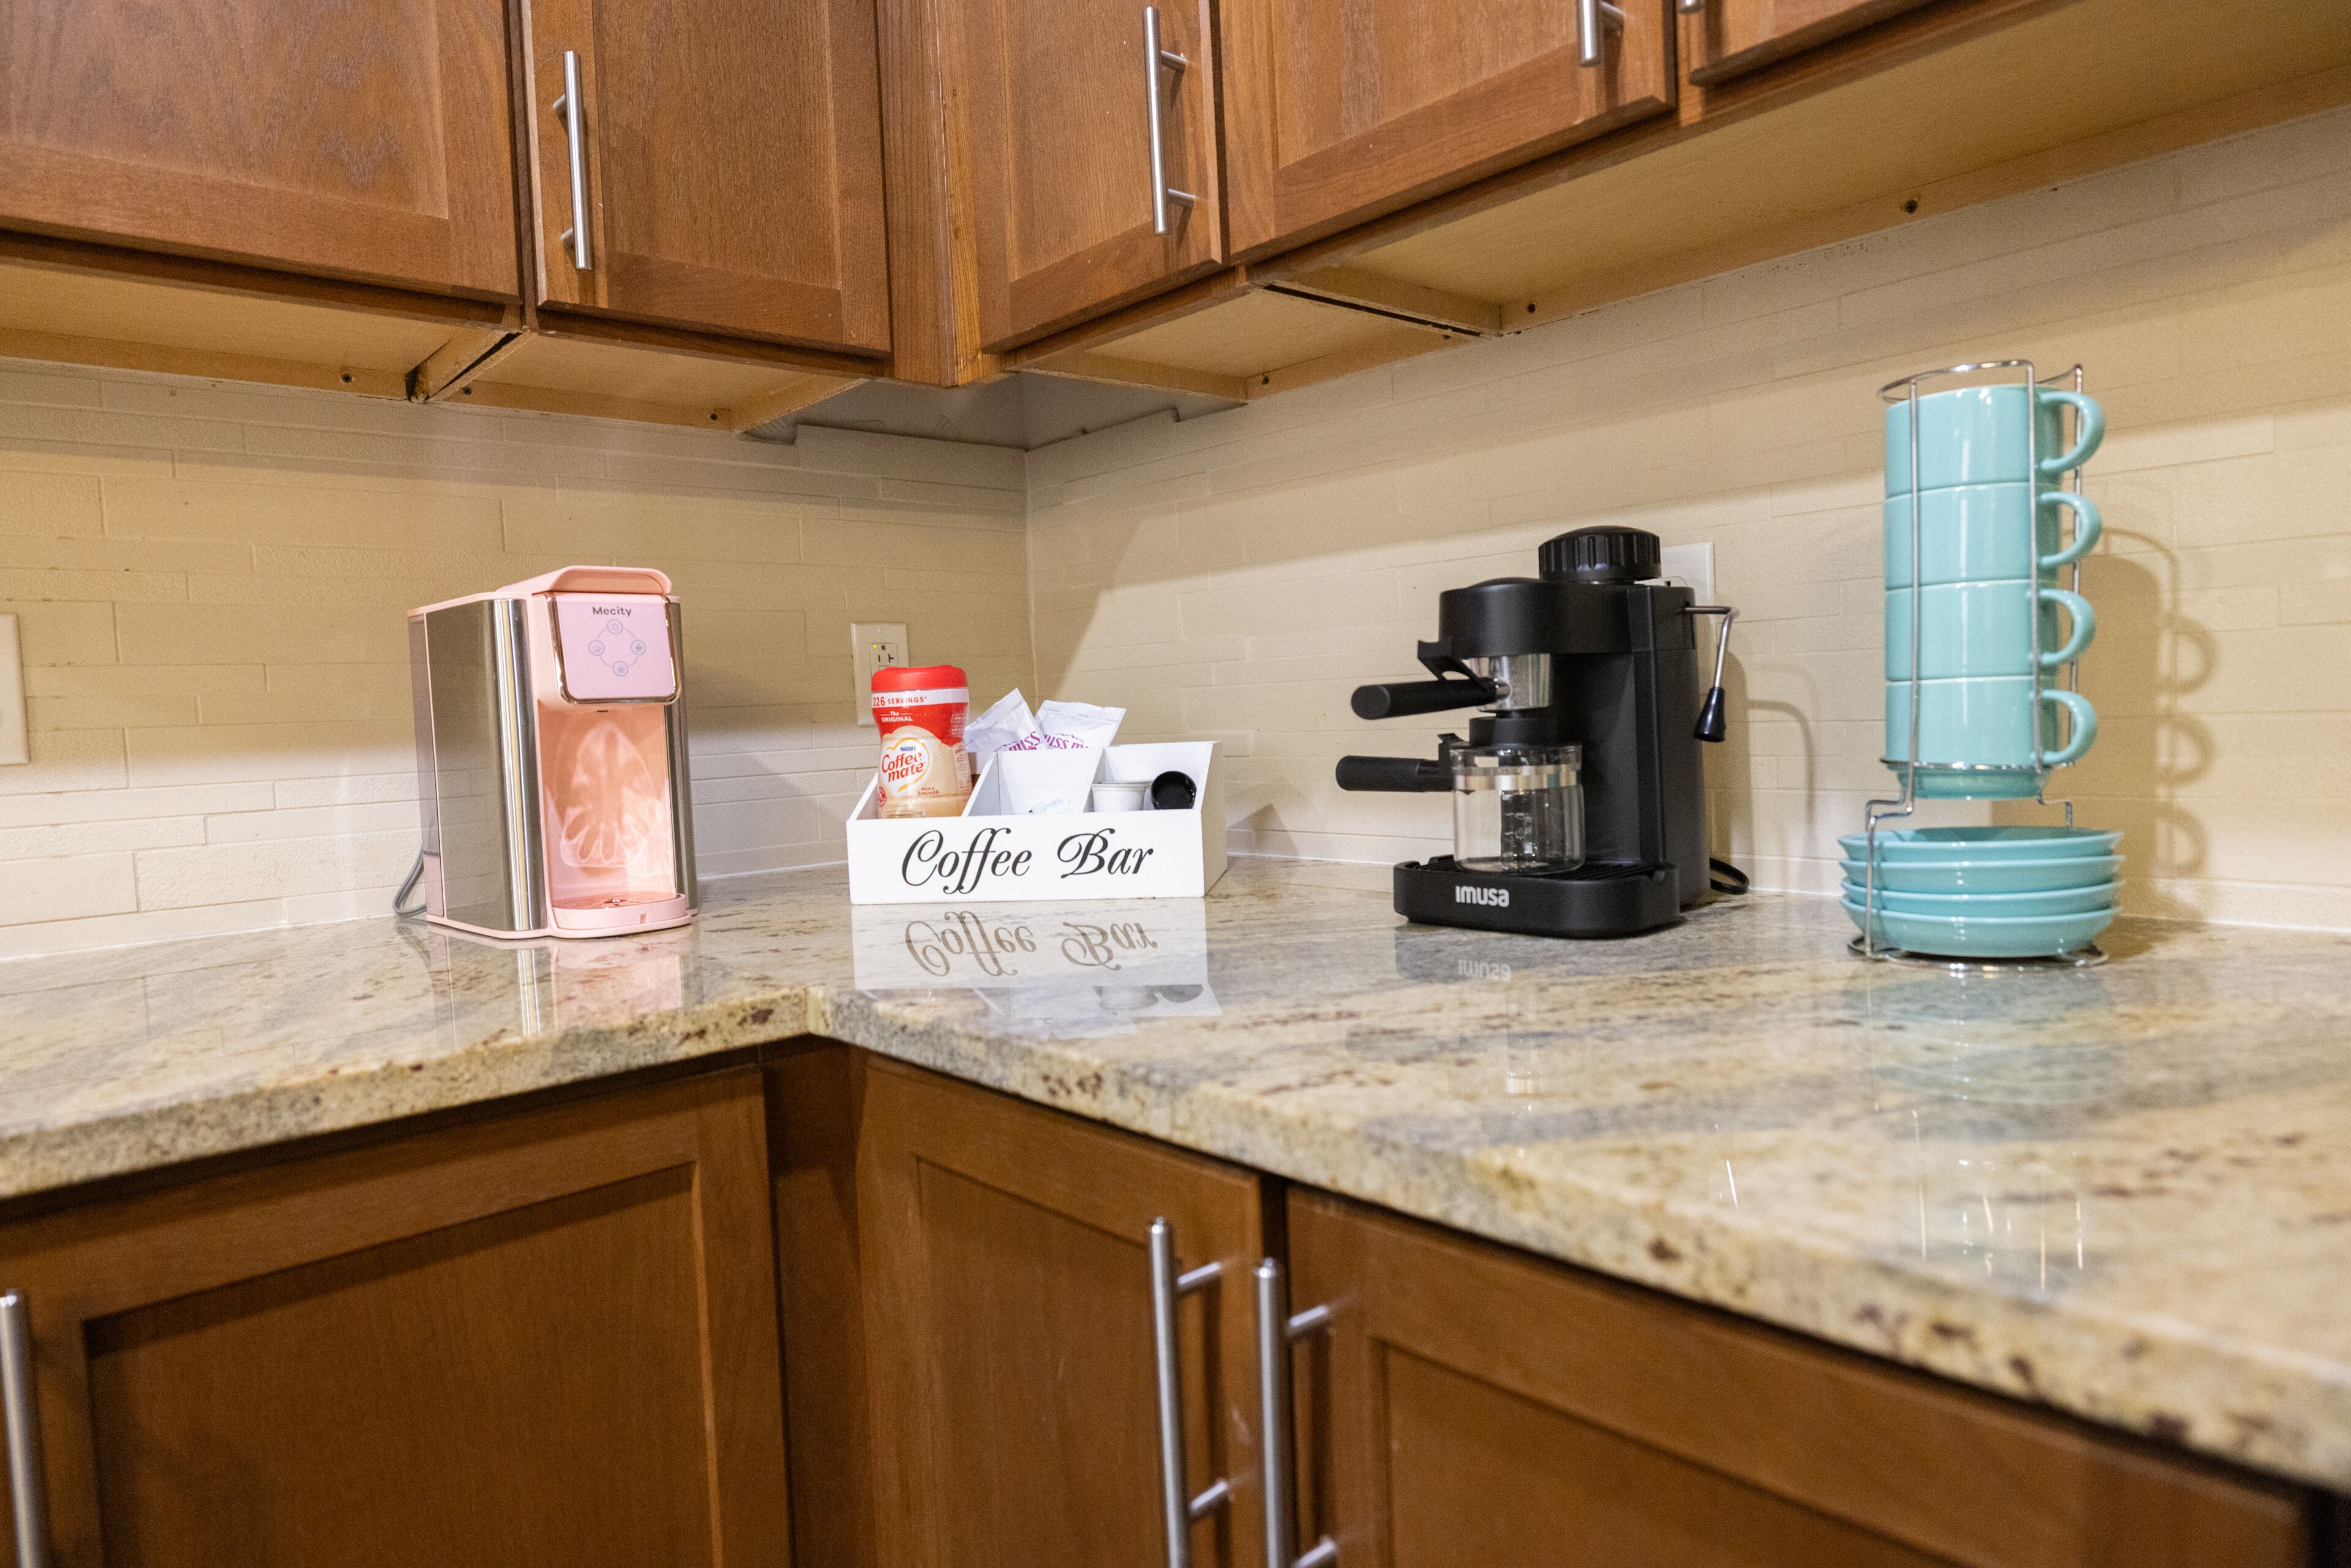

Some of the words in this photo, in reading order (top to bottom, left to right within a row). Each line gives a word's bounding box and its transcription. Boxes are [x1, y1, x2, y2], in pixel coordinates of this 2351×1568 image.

[592, 606, 631, 617] Mecity
[873, 696, 885, 707] 226
[882, 752, 922, 773] Coffee
[888, 762, 924, 782] mate
[902, 828, 1032, 894] Coffee
[1057, 828, 1153, 879] Bar
